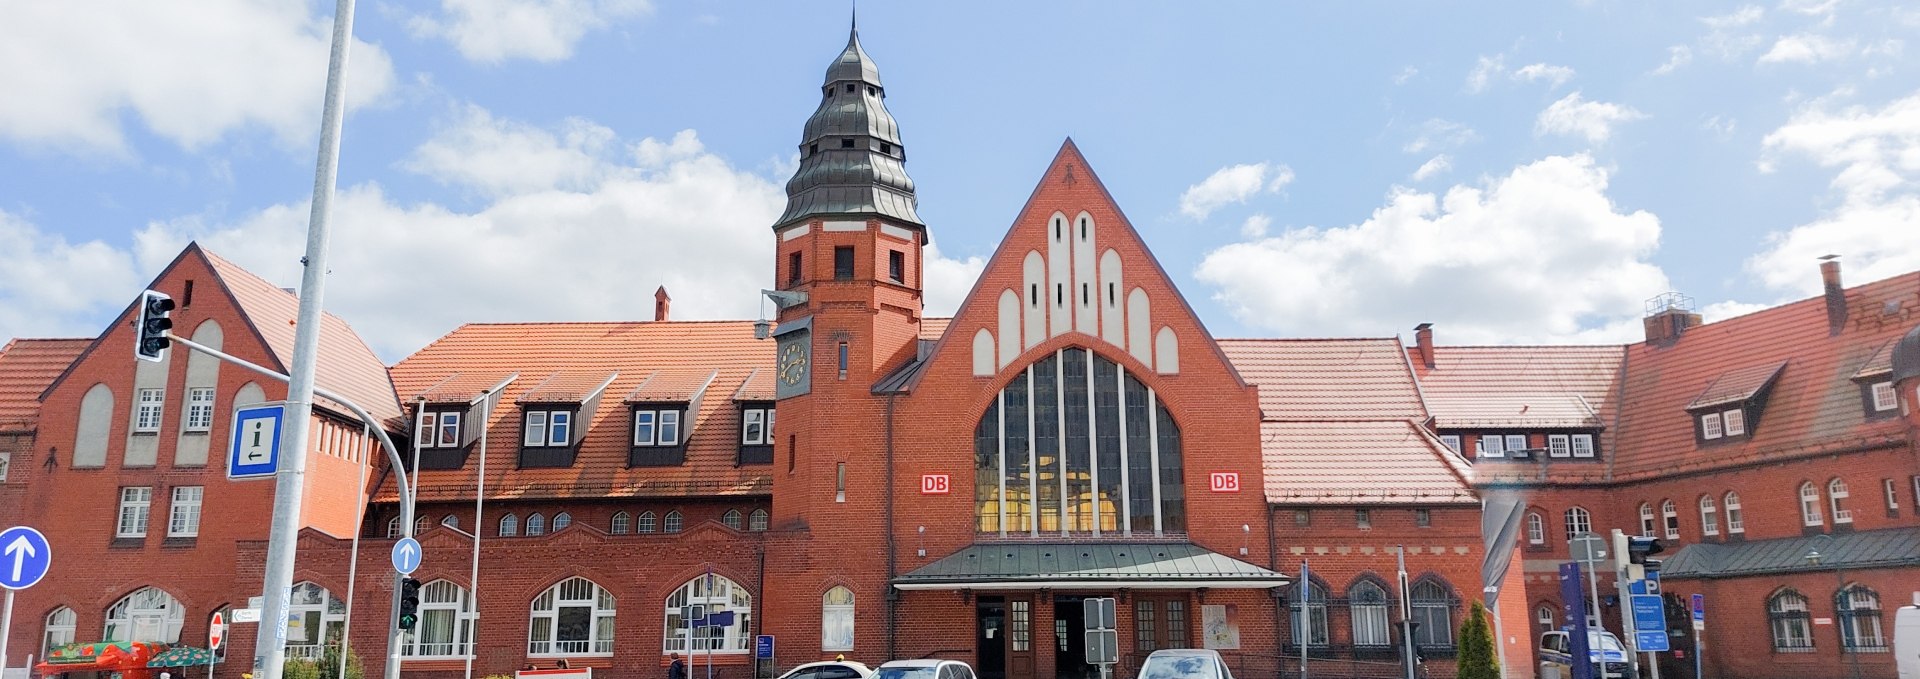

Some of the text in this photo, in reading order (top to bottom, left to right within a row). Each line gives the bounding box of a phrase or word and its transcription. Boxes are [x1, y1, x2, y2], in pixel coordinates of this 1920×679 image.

[924, 476, 946, 491] DB
[1213, 474, 1236, 489] DB
[1645, 579, 1658, 594] P
